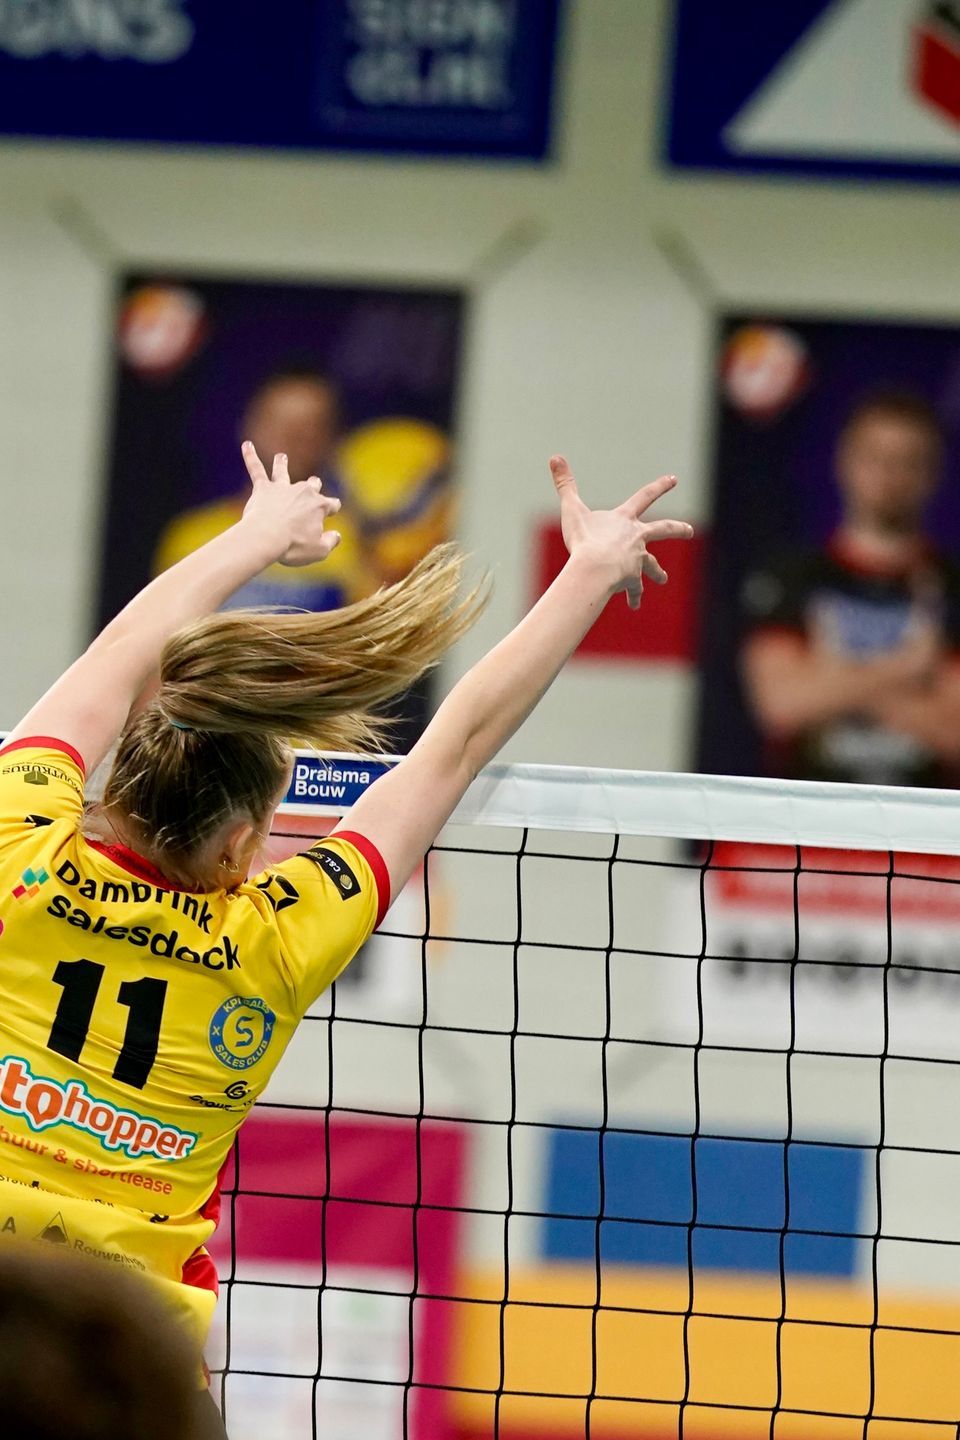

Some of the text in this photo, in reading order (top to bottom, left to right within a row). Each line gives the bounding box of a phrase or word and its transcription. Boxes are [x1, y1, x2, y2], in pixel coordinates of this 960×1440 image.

[294, 780, 346, 798] Bouw
[295, 764, 370, 784] Draisma
[55, 859, 214, 934] Dambrink
[46, 894, 242, 971] salesdock
[46, 958, 169, 1090] 11
[215, 1044, 246, 1068] SALES
[53, 1149, 67, 1165] &
[72, 1157, 173, 1195] shortlease
